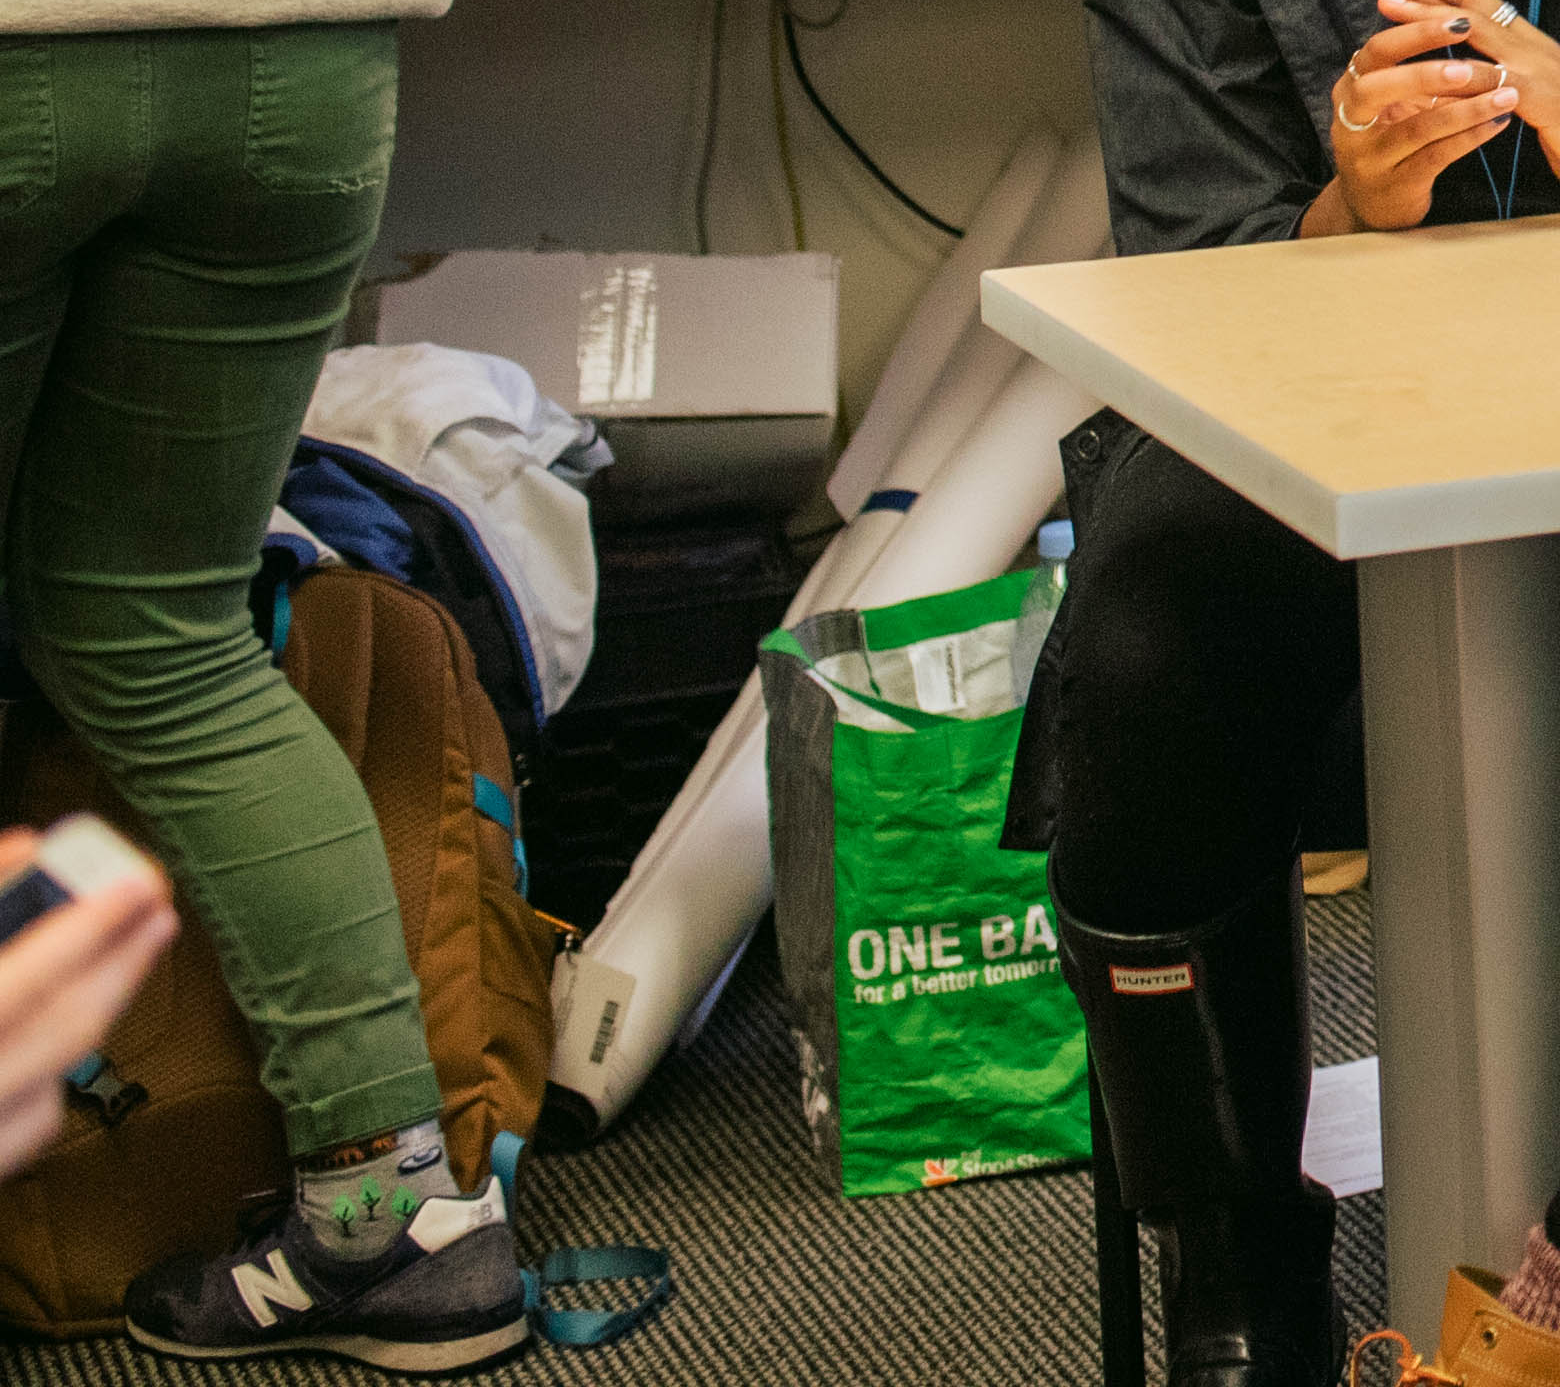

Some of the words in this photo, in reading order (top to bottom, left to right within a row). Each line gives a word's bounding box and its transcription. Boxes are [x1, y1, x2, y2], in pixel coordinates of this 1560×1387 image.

[847, 922, 964, 981] ONE
[853, 983, 886, 1005] for
[891, 979, 907, 1001] a
[912, 968, 979, 996] better
[1116, 971, 1187, 987] HUNTER
[231, 1248, 314, 1328] N
